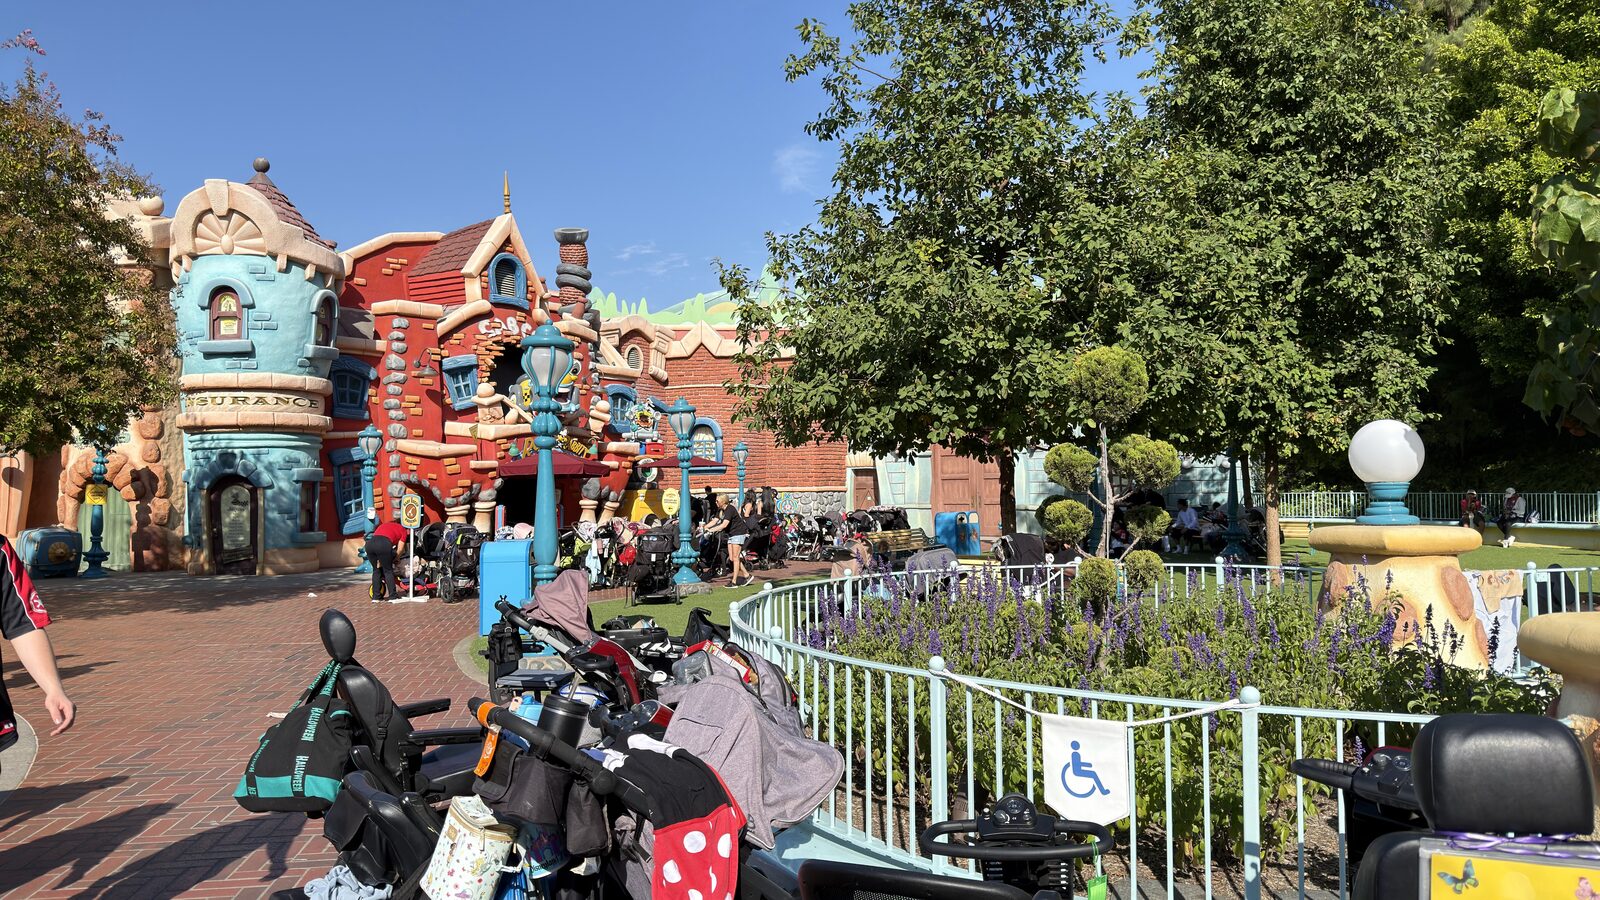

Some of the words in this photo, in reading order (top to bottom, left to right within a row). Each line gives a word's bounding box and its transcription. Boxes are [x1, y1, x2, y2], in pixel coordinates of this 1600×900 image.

[185, 396, 319, 409] NSURANCE
[301, 707, 325, 742] HALLOWEEN
[292, 755, 309, 792] HALLOWEEN
